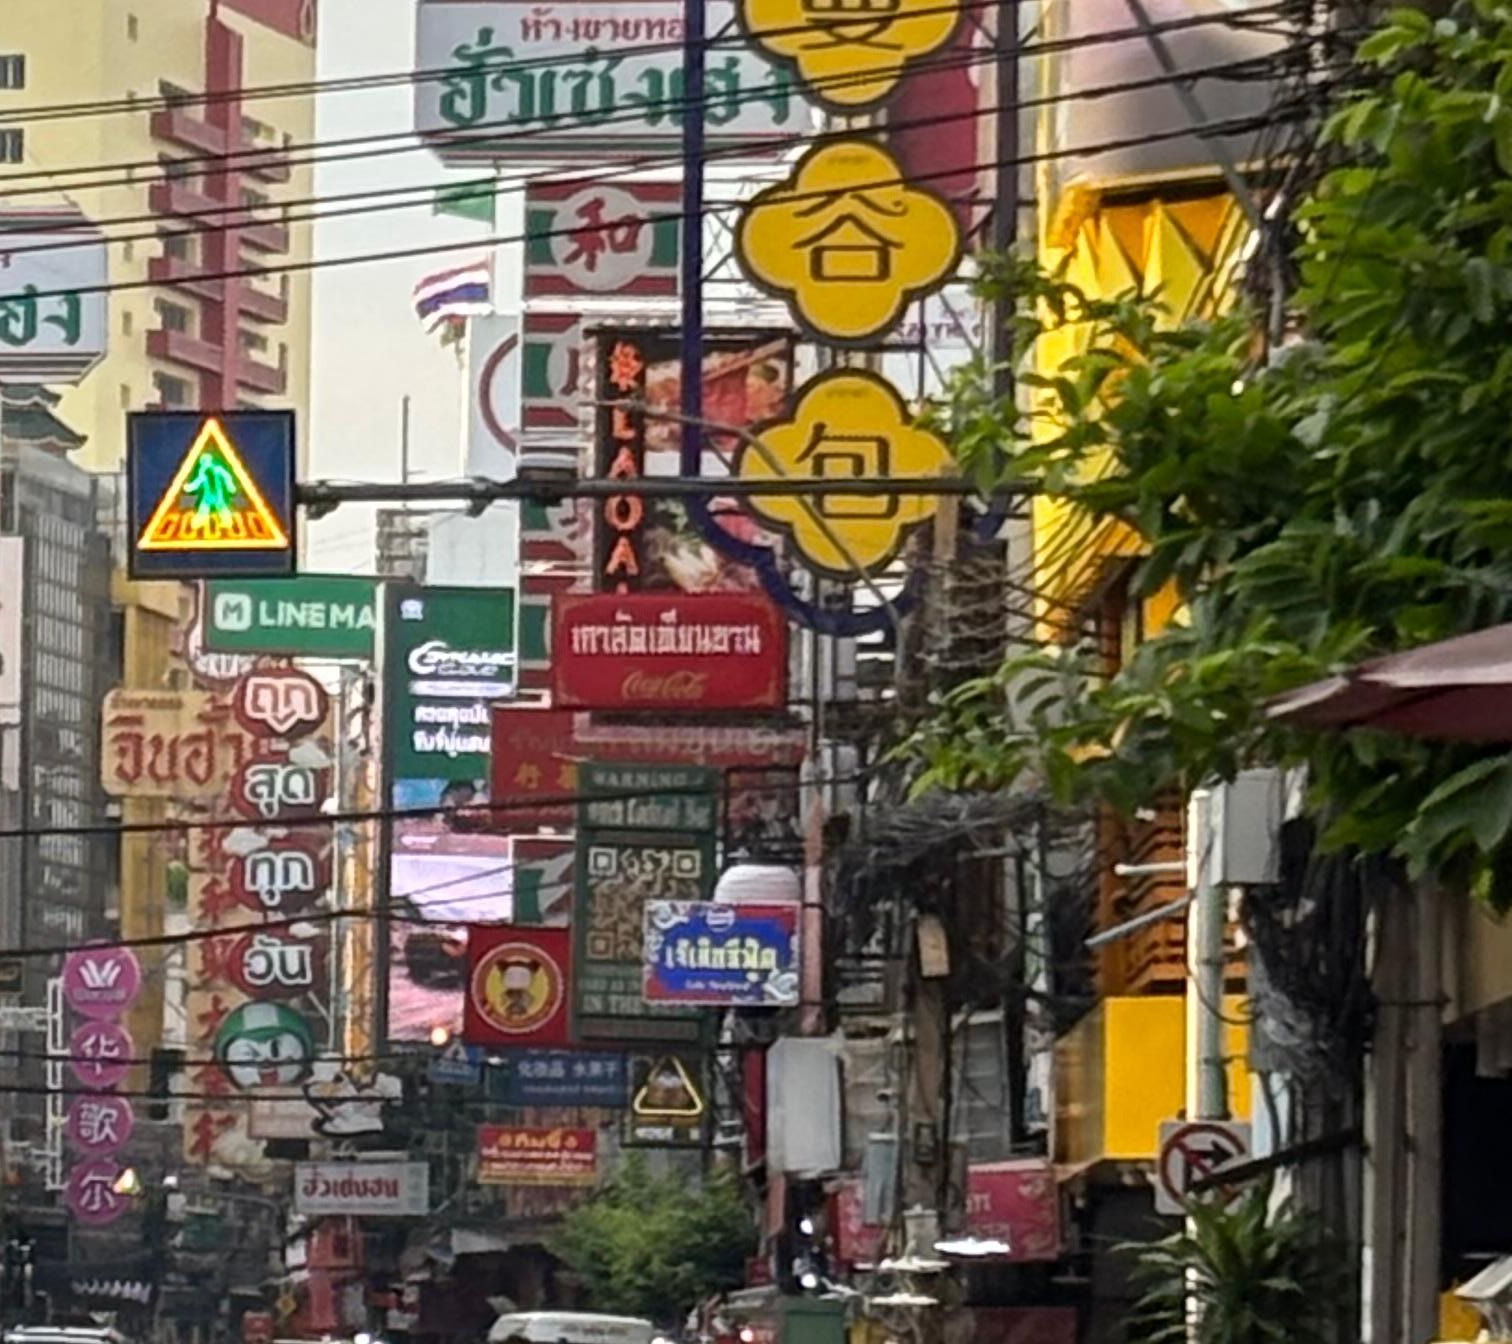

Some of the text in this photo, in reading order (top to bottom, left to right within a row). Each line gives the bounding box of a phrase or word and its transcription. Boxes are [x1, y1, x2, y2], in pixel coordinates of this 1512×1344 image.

[519, 6, 687, 42] ห้างขายทอ
[330, 602, 376, 628] MA
[243, 935, 312, 985] วัน
